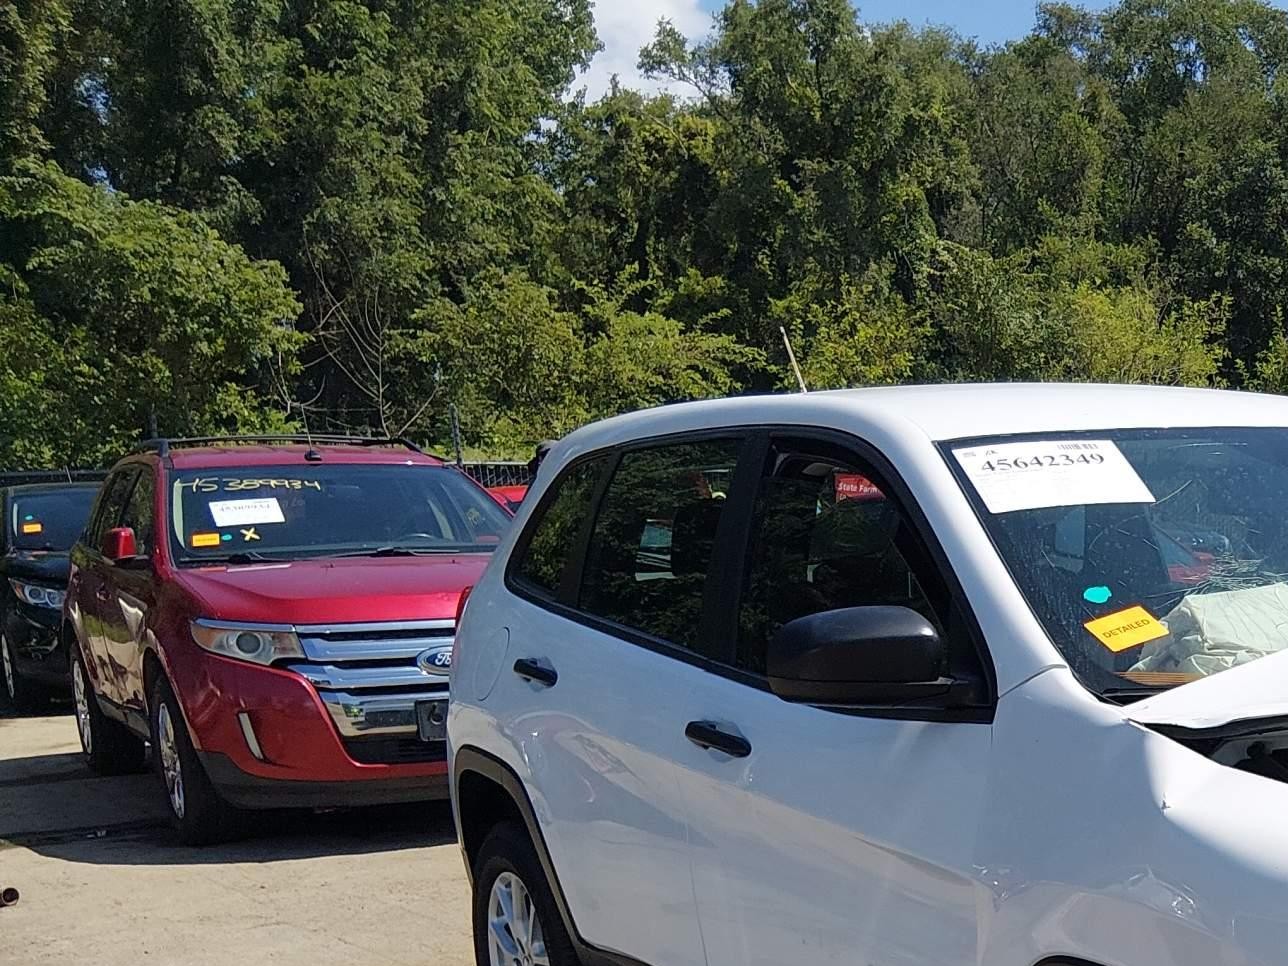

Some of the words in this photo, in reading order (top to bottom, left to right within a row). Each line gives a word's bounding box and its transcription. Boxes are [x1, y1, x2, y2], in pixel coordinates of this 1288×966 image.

[981, 453, 1105, 472] 45642349
[837, 482, 858, 492] State
[1102, 617, 1150, 639] DETAILED
[434, 652, 452, 666] Fo
